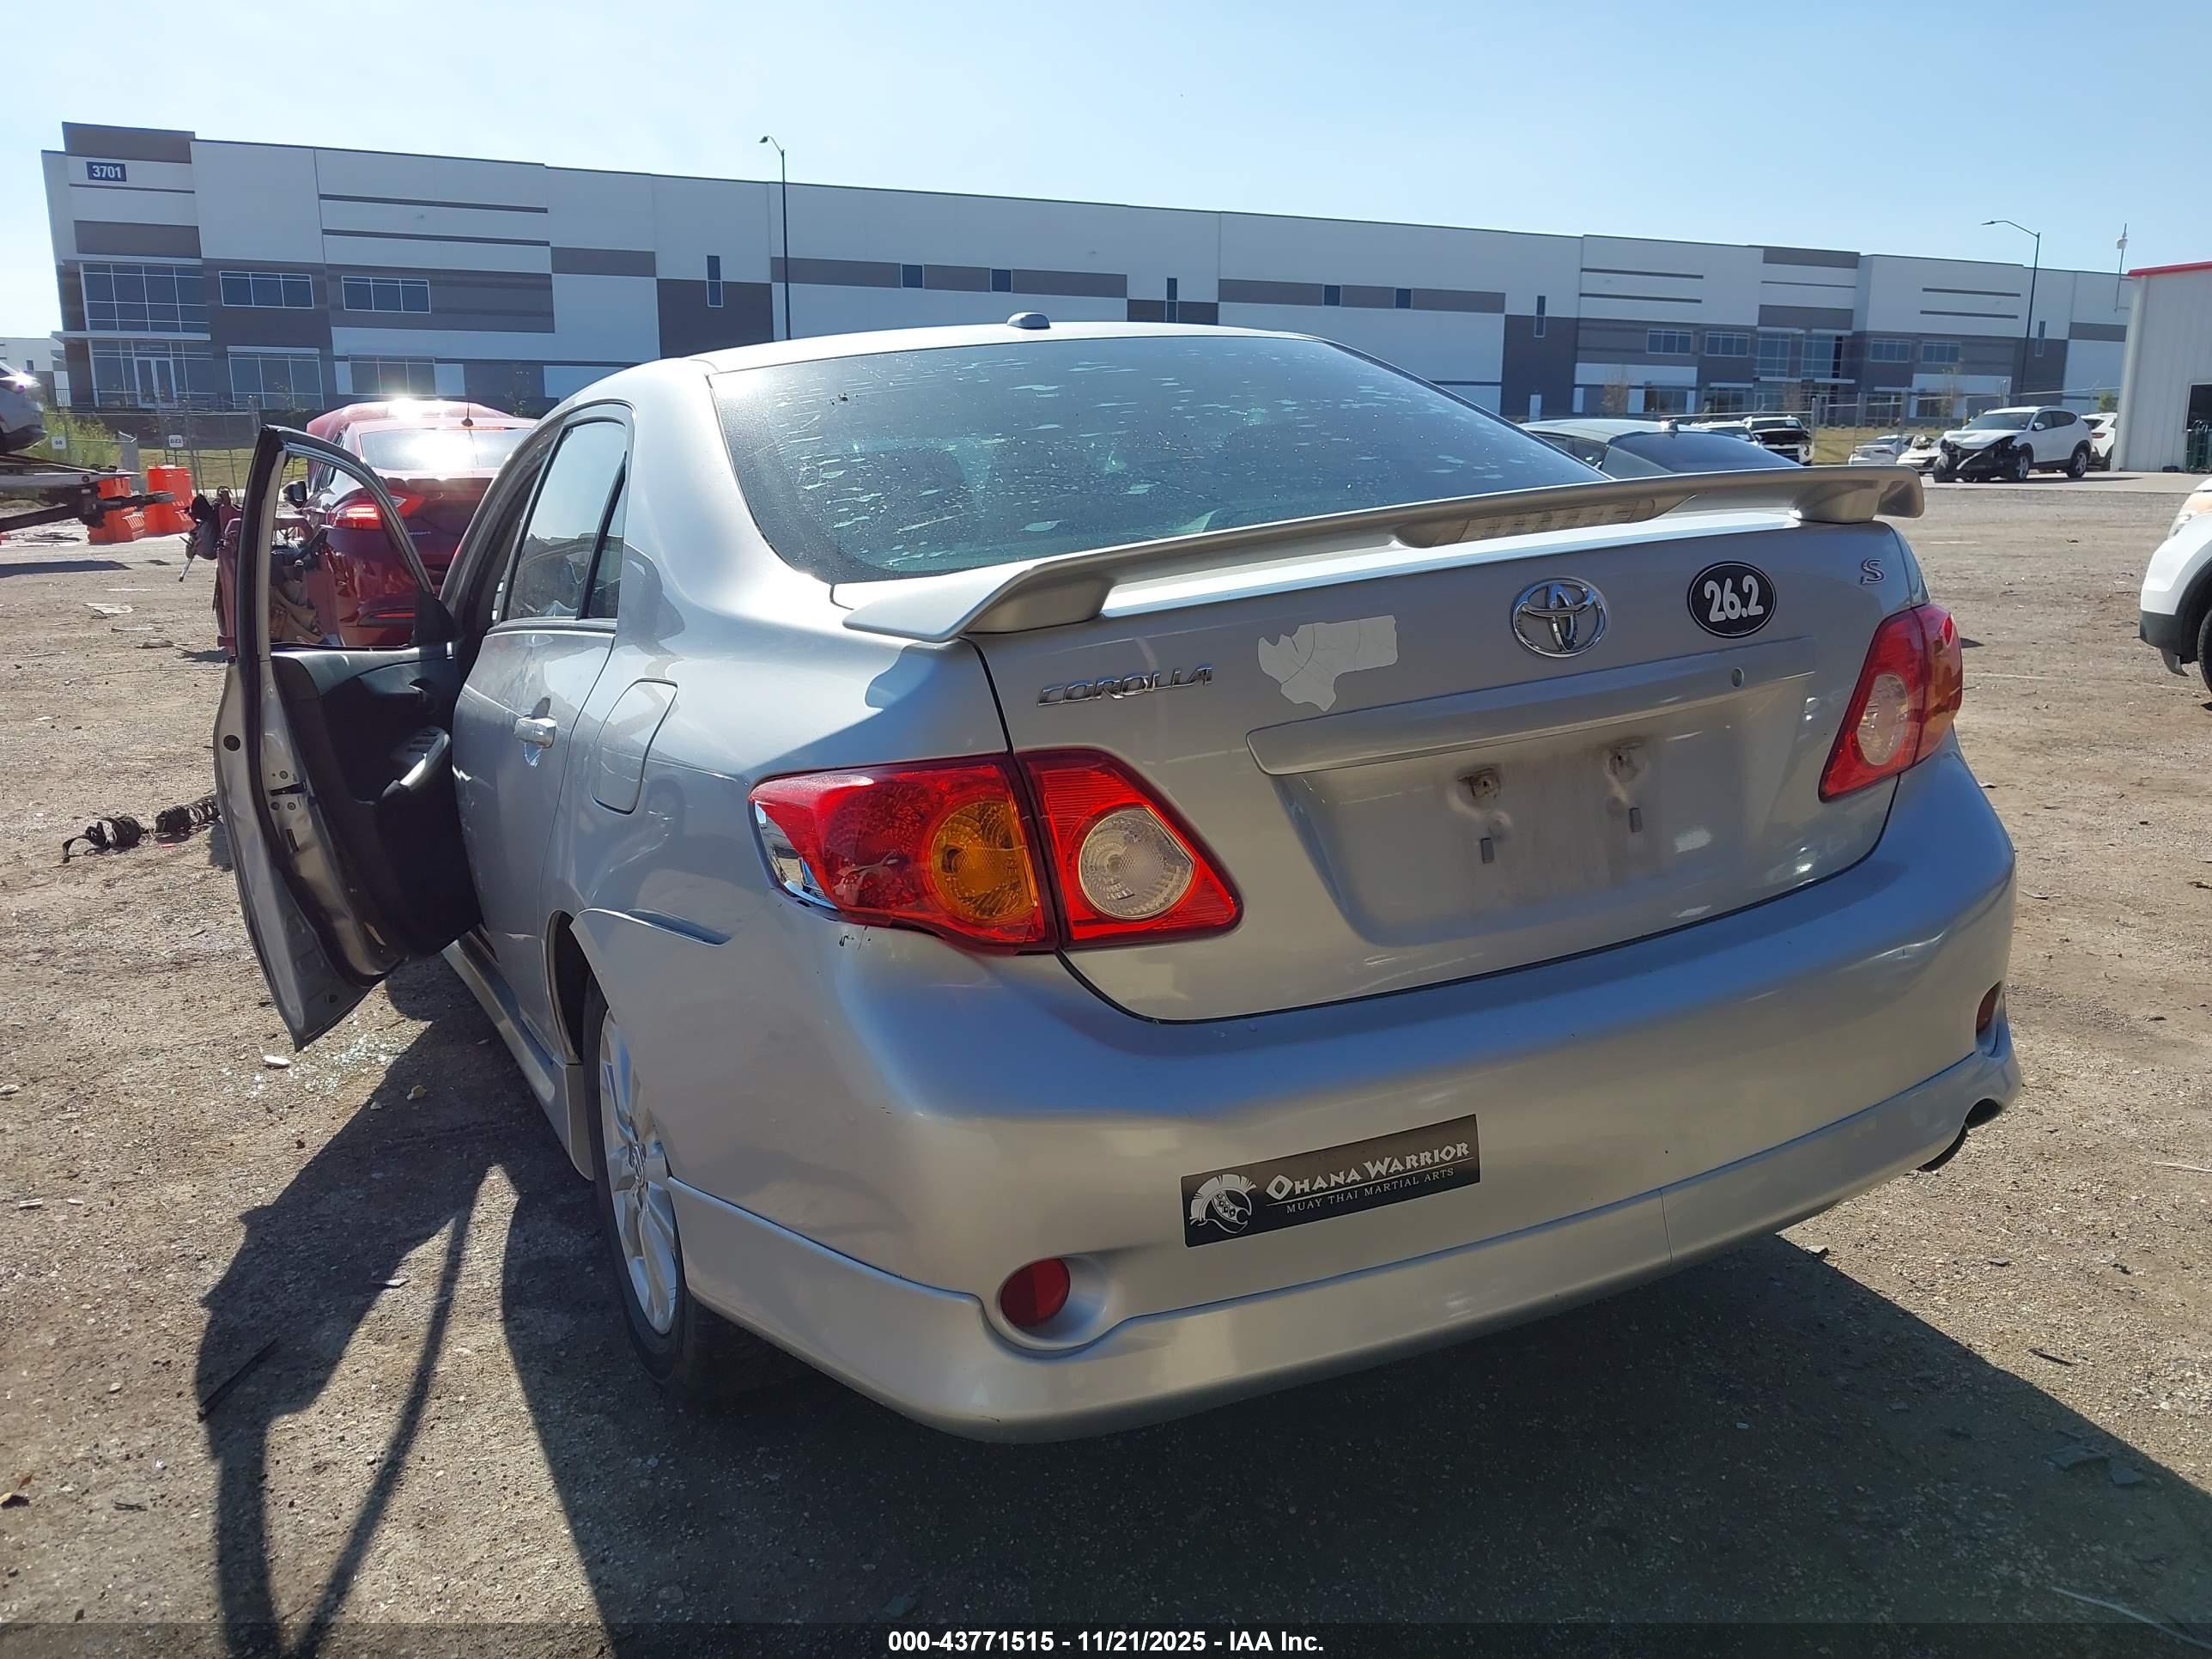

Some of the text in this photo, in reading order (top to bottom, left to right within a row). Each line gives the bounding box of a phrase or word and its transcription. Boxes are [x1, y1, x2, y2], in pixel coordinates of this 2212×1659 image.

[92, 165, 122, 179] 3701
[1860, 558, 1885, 585] S
[1704, 574, 1765, 623] 26.2
[1037, 665, 1213, 707] COROLLA
[1266, 1141, 1470, 1200] OHANA WARRIOR
[1286, 1167, 1455, 1214] MUAY THAI MARTIAL ARTS
